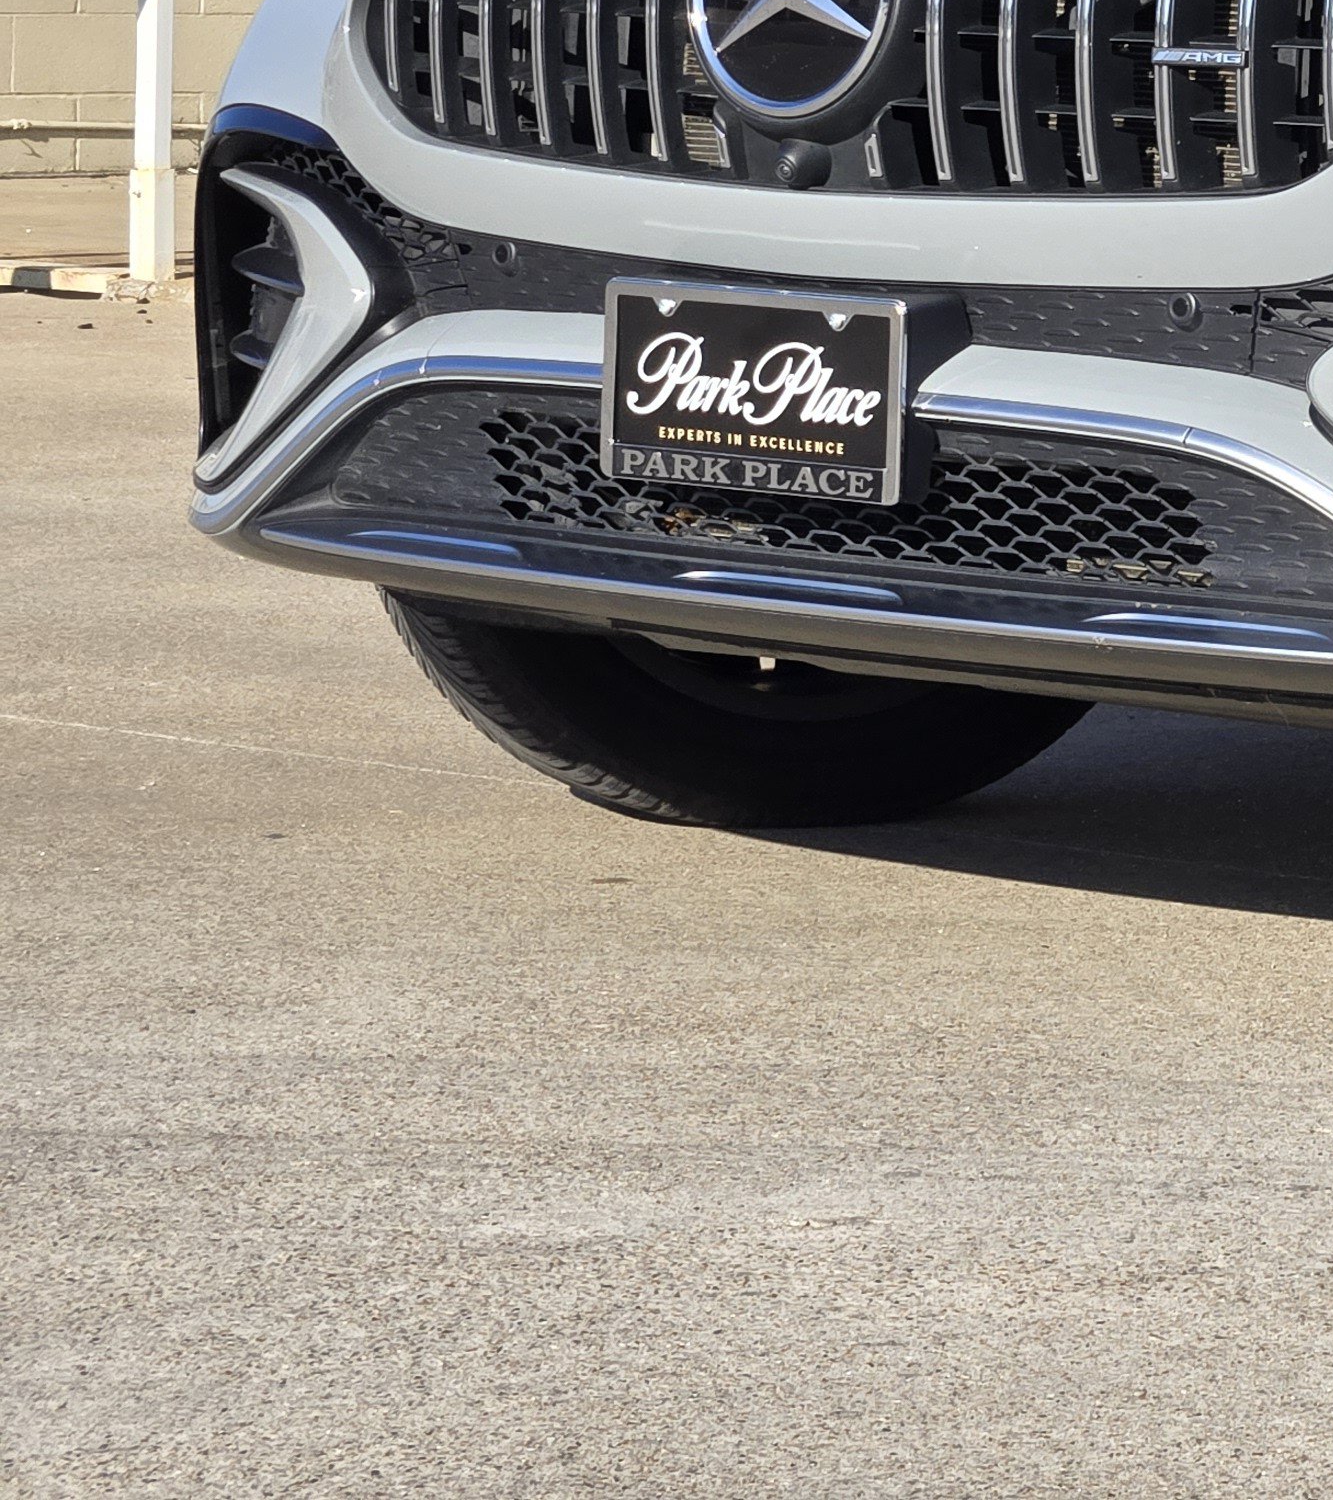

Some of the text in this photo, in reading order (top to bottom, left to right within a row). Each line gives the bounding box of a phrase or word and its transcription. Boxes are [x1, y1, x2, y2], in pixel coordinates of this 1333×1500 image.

[1181, 52, 1241, 63] AMG
[626, 332, 881, 426] Park Place
[658, 426, 845, 455] EXPERTS IN EXCELLENCE
[620, 449, 874, 499] PARK PLACE
